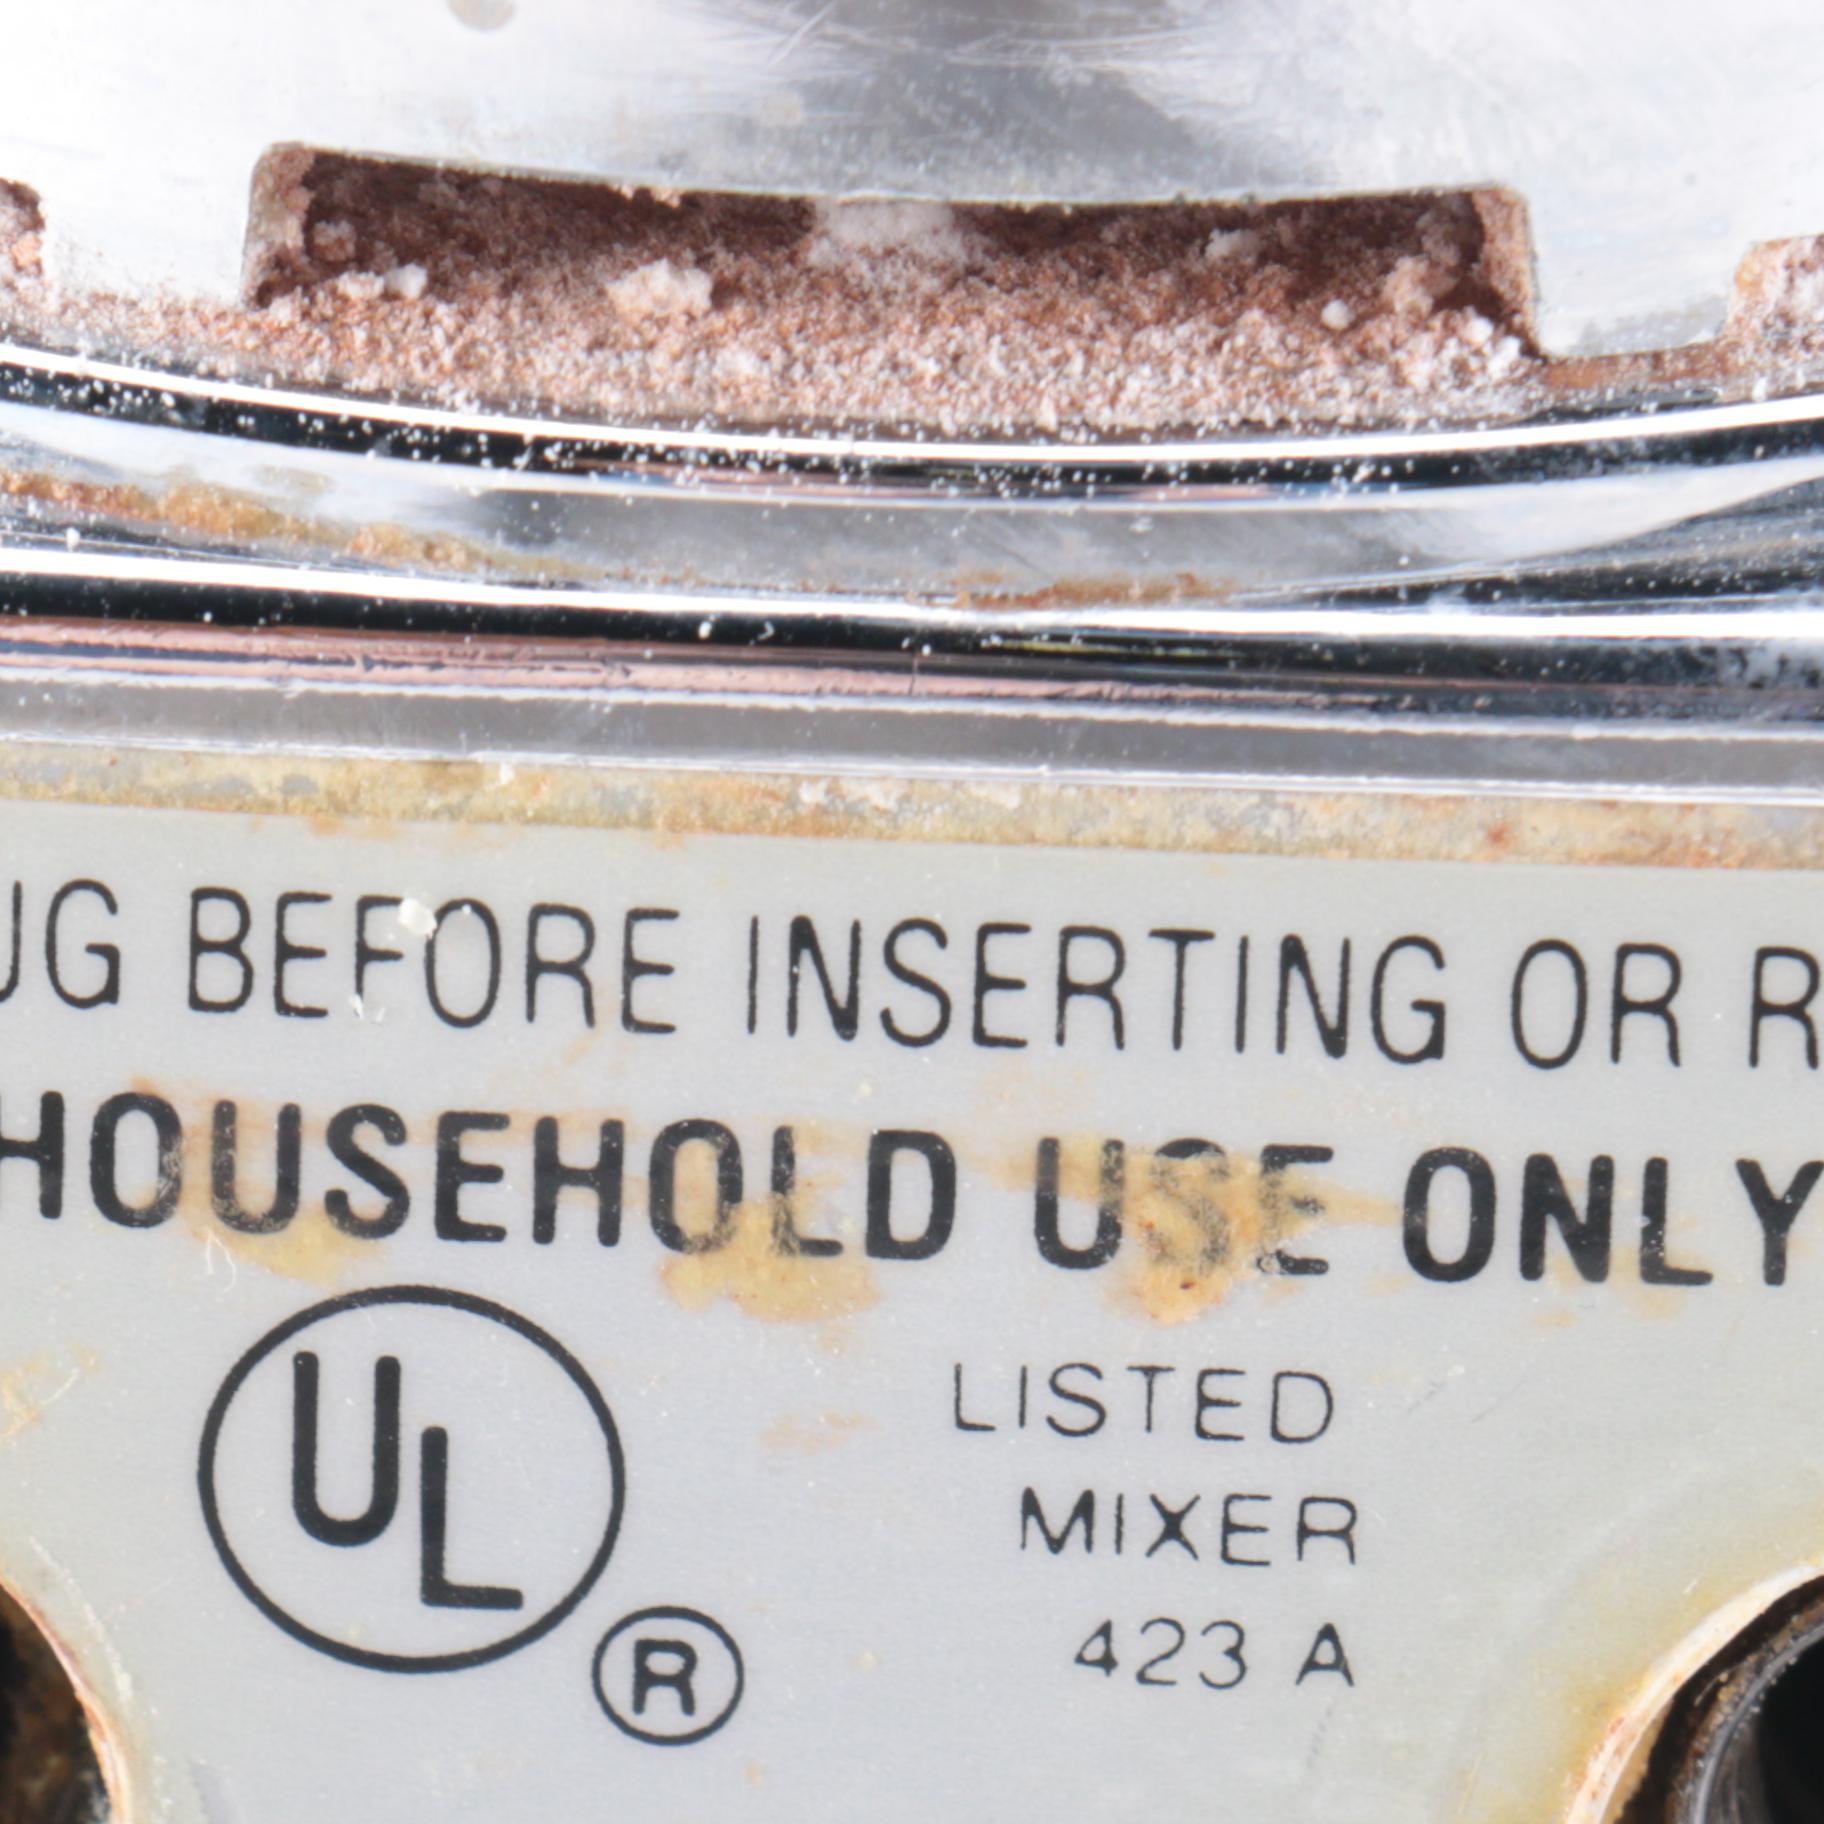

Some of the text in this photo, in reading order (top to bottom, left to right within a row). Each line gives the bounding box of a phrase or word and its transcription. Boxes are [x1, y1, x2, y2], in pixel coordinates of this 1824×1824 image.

[187, 886, 680, 1035] BEFORE
[746, 914, 1447, 1066] INSERTING
[1510, 938, 1683, 1071] OR
[1033, 1136, 1335, 1277] USE
[953, 1362, 1335, 1445] LISTED
[291, 1350, 524, 1612] UL
[1020, 1486, 1358, 1568] MIXER
[1074, 1616, 1355, 1691] 423 A
